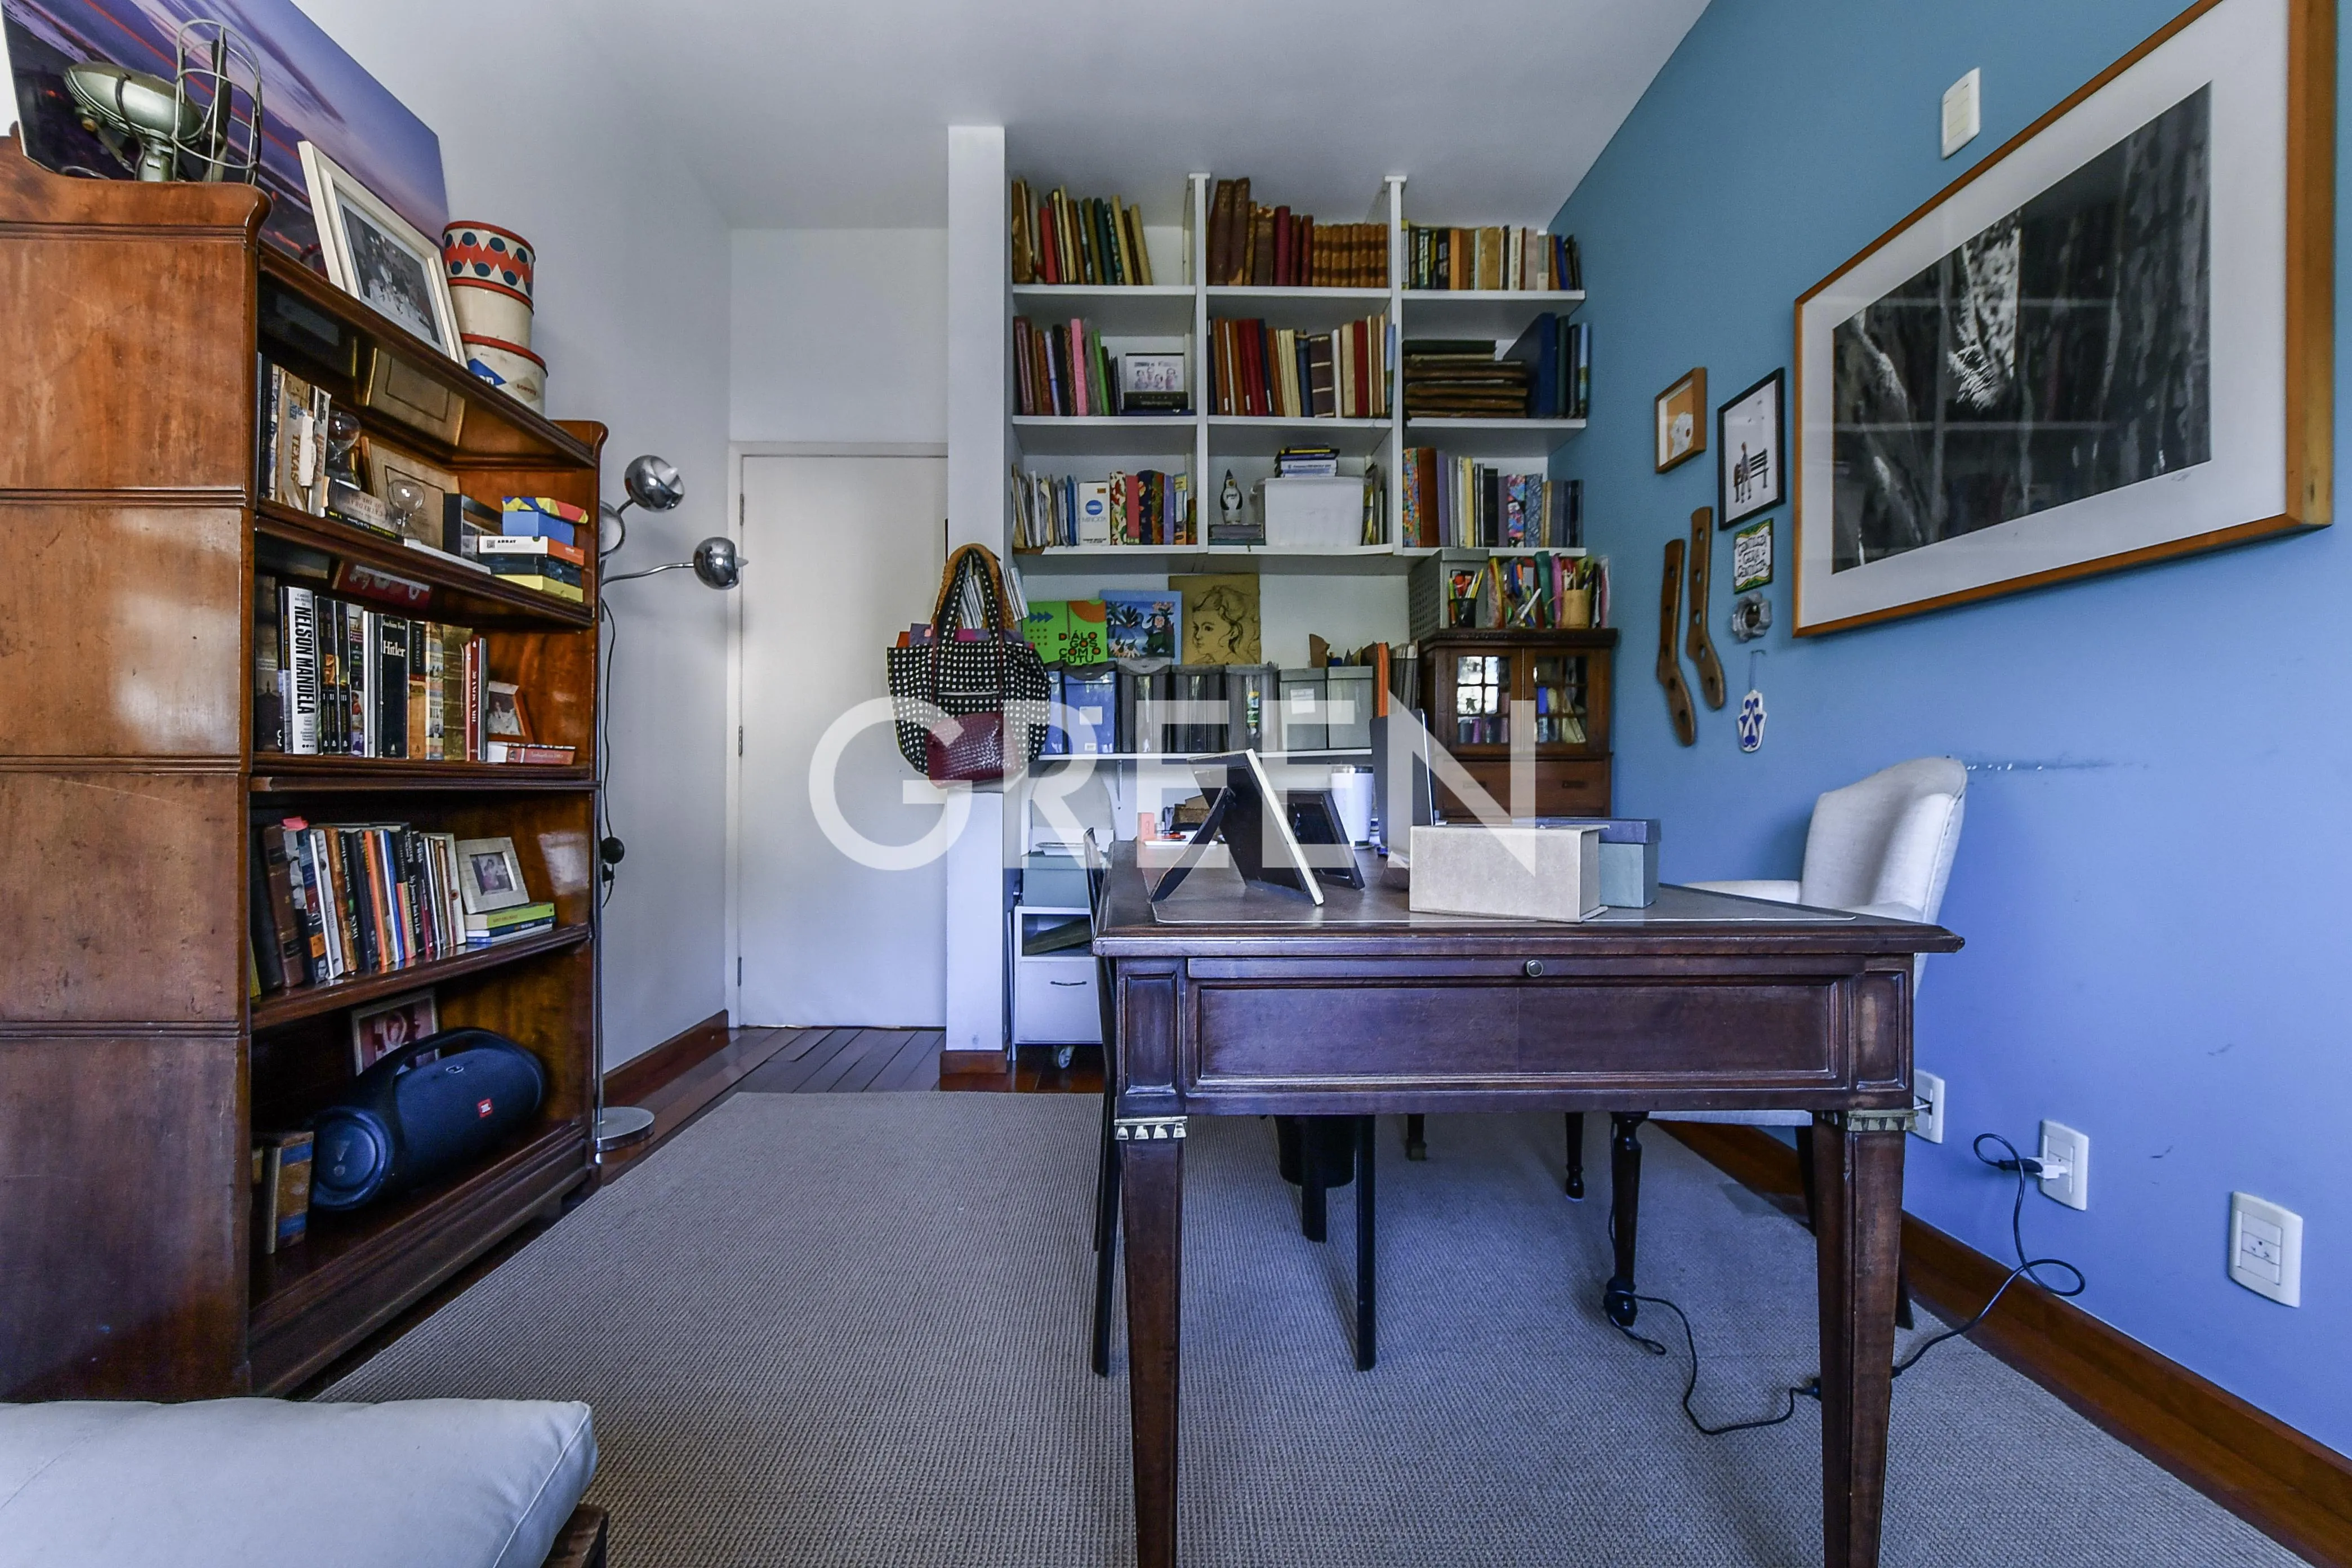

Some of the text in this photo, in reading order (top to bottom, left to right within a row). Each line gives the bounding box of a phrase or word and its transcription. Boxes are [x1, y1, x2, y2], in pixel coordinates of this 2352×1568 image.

[290, 434, 301, 483] TEXAS
[294, 605, 313, 654] NELSON
[383, 639, 406, 658] Hitler
[296, 657, 315, 715] MANDELA
